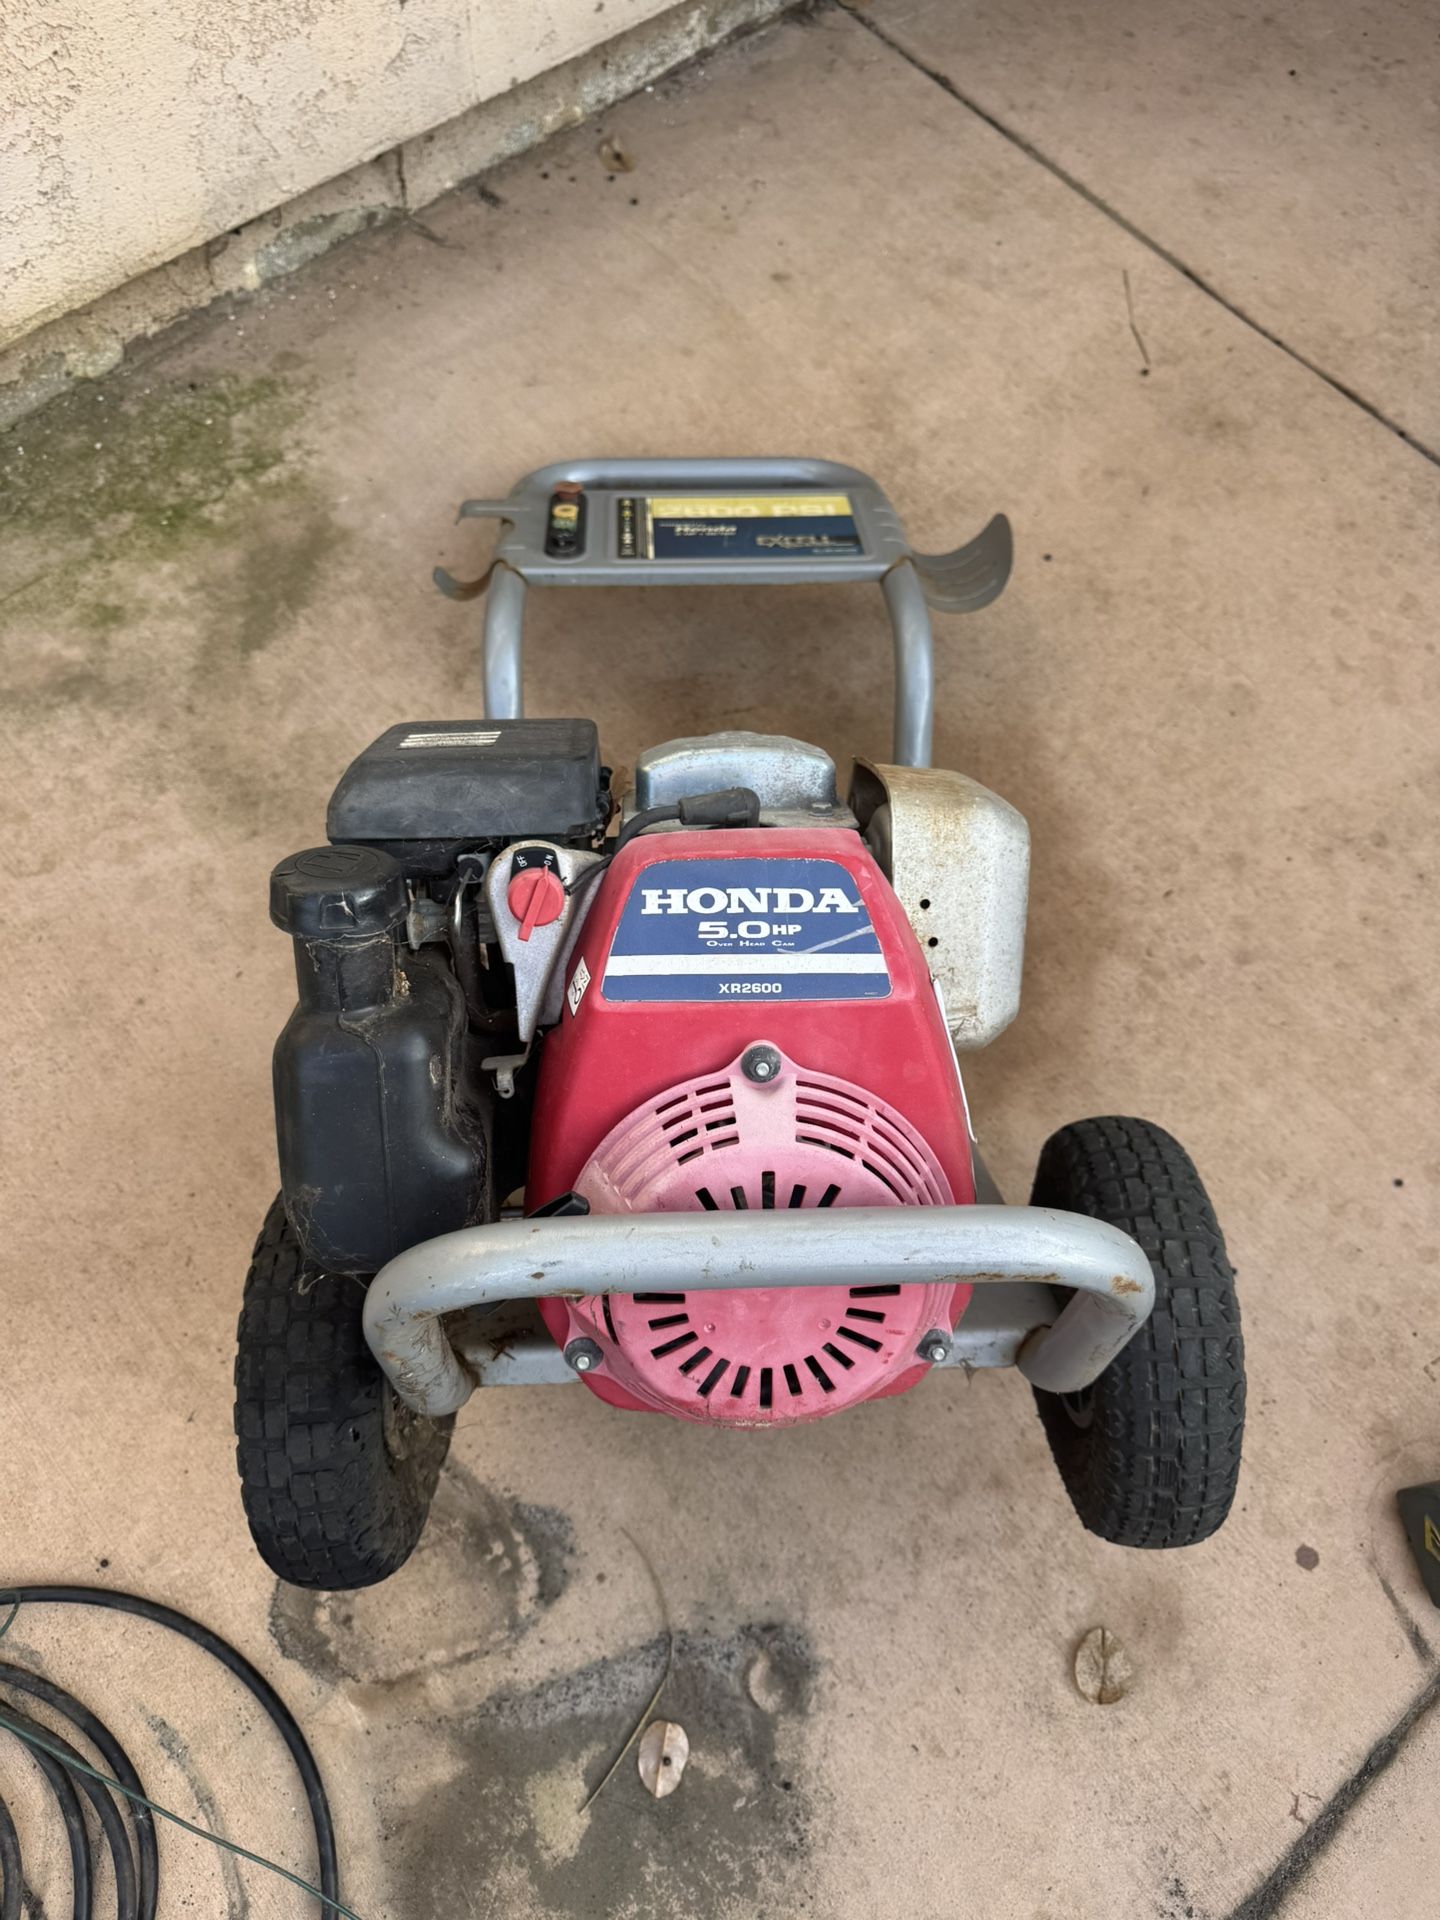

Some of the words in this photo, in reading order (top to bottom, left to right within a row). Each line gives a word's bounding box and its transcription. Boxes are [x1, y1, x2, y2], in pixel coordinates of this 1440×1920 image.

[516, 854, 528, 867] OFF
[543, 853, 554, 866] ON
[641, 887, 859, 914] HONDA
[718, 982, 782, 994] XR2600
